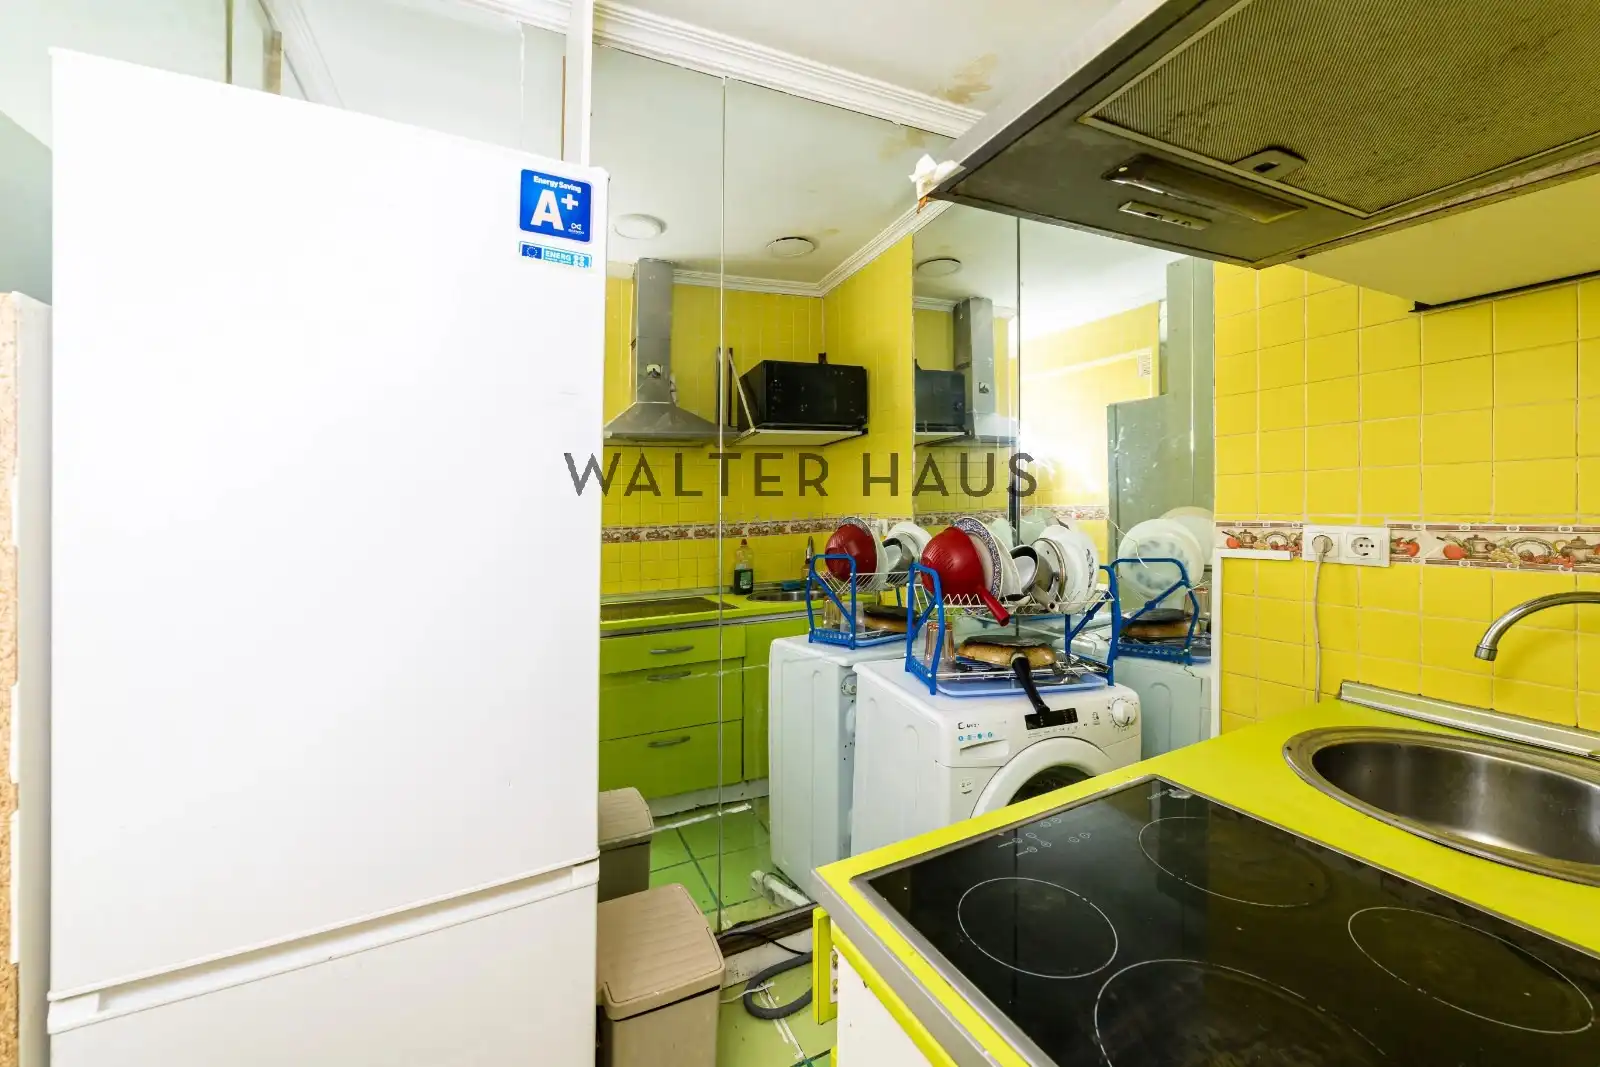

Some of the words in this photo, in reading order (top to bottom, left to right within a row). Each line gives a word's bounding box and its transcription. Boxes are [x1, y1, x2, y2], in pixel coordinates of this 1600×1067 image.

[533, 175, 559, 188] Energy
[559, 181, 581, 193] Saving
[530, 188, 579, 230] A+
